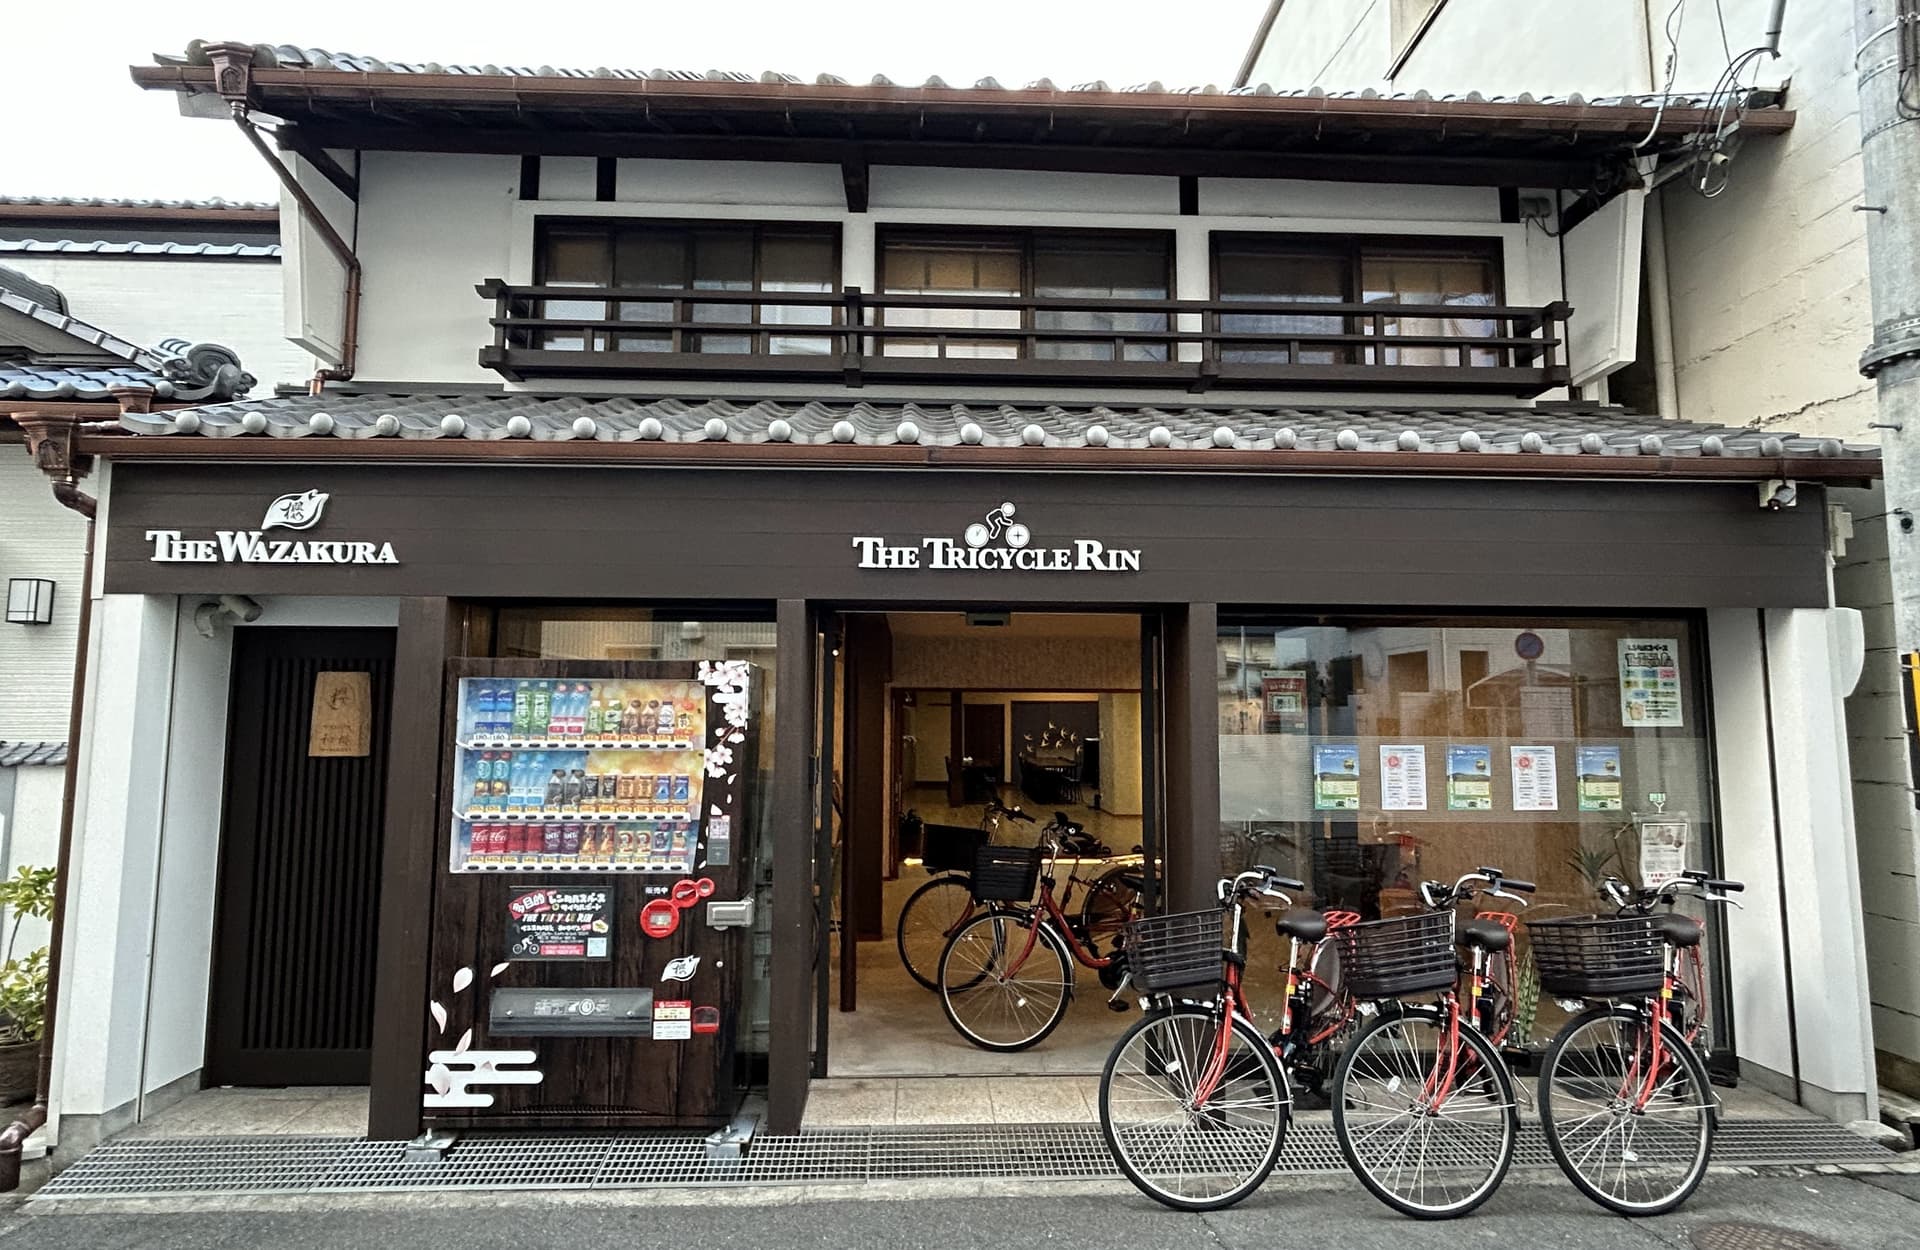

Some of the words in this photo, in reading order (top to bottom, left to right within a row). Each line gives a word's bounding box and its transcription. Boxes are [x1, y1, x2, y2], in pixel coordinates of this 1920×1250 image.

[145, 530, 217, 563] THE
[216, 530, 399, 565] WAZAKURA
[852, 536, 920, 569] THE
[922, 537, 1072, 571] TRICYCLE
[1074, 539, 1142, 571] RIN
[511, 893, 545, 914] 多目的
